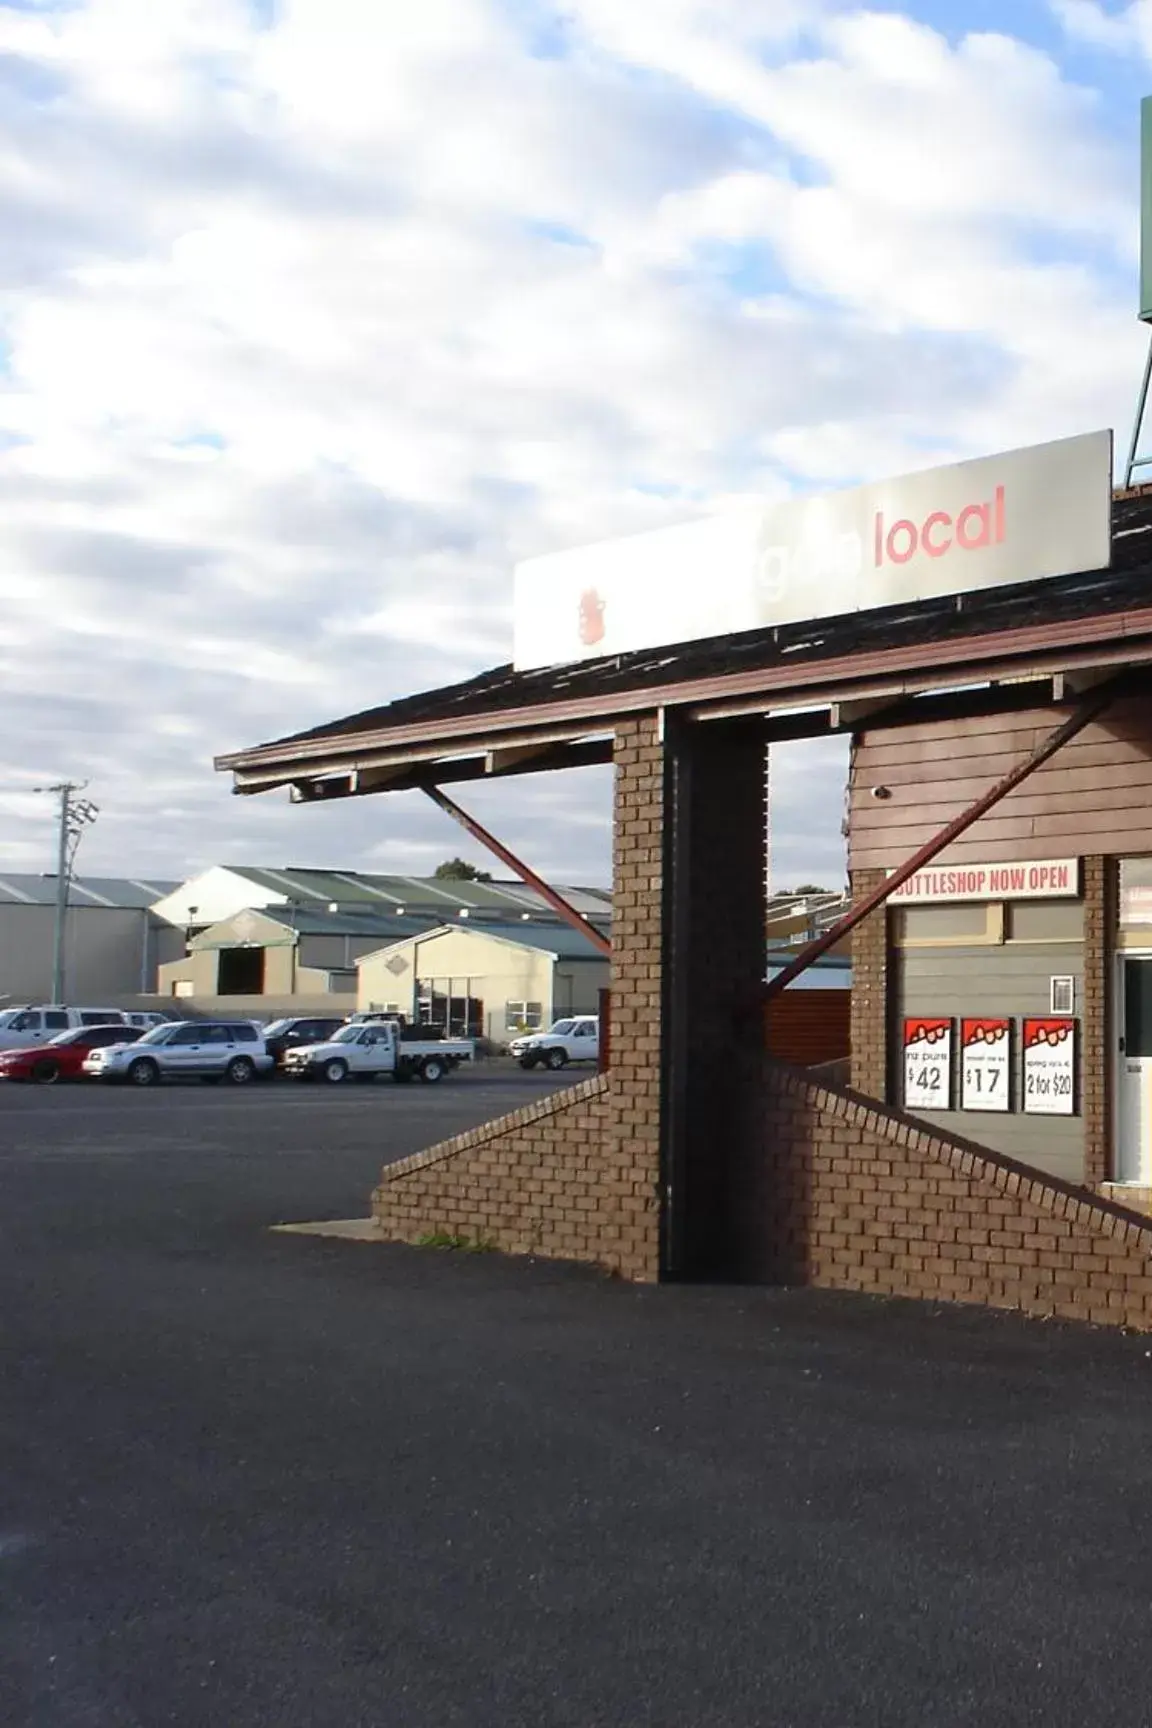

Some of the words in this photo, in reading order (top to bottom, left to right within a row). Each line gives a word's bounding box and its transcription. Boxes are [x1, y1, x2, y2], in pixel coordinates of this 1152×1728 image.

[874, 484, 1008, 569] local
[989, 868, 1027, 892] NOW
[1029, 865, 1069, 890] OPEN
[1027, 1074, 1035, 1095] 2
[1036, 1074, 1051, 1095] for
[1053, 1072, 1072, 1097] $20
